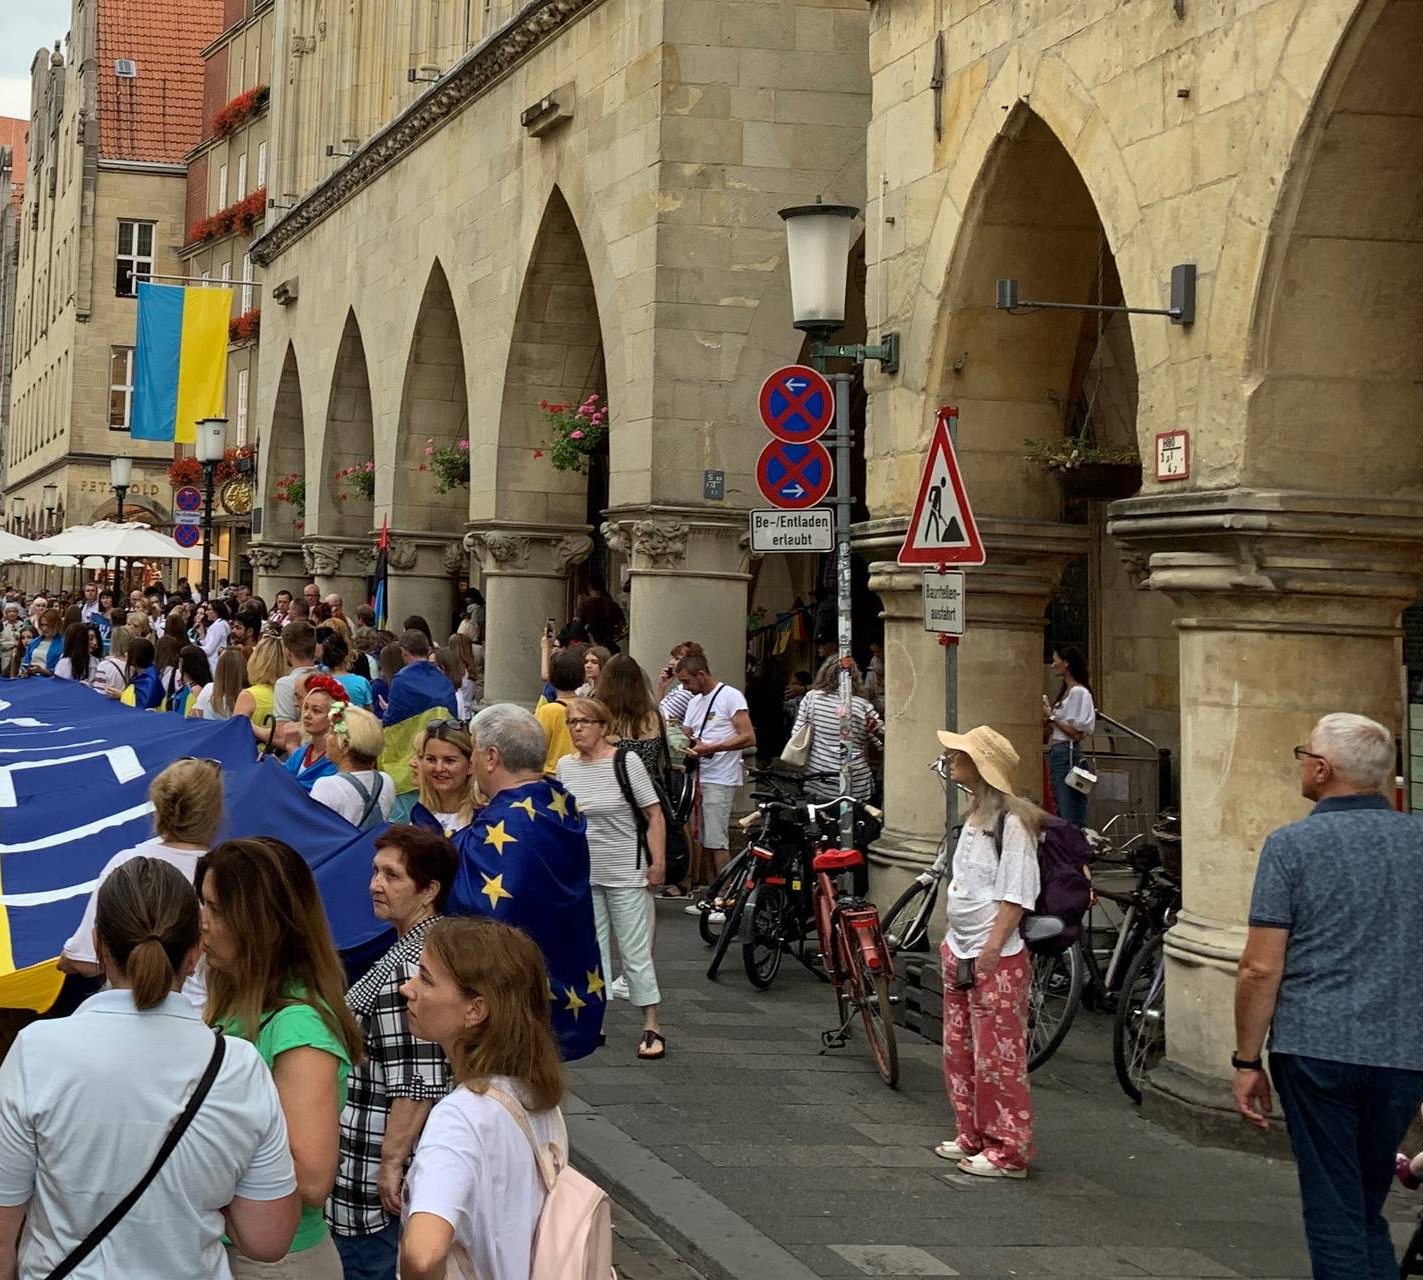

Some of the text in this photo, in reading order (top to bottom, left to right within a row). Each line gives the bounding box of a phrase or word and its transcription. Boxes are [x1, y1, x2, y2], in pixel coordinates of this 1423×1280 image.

[80, 480, 160, 496] PETZOLD
[755, 515, 829, 529] Be-/Entladen
[772, 533, 813, 546] erlaubt
